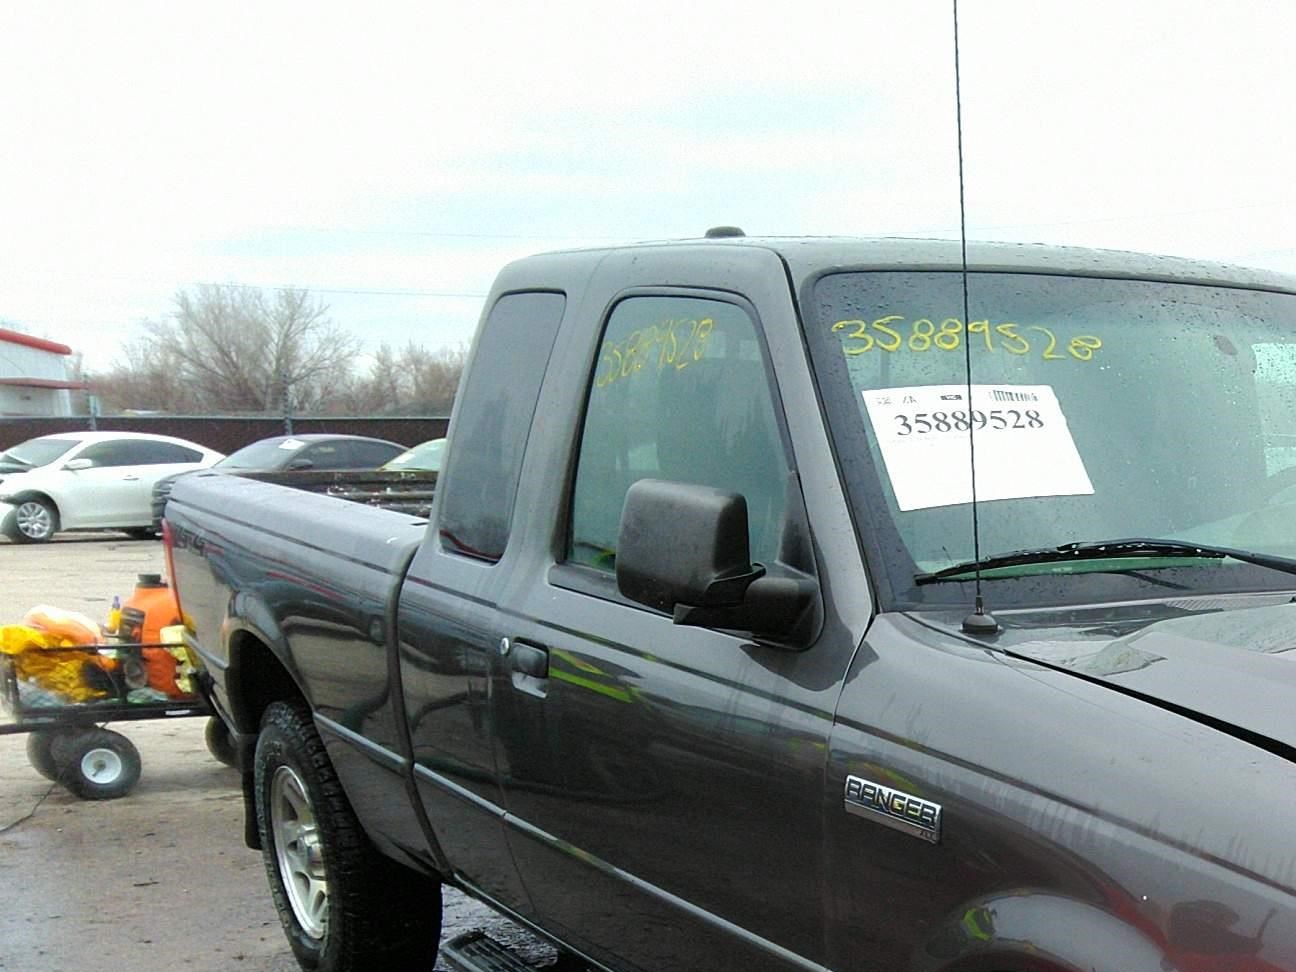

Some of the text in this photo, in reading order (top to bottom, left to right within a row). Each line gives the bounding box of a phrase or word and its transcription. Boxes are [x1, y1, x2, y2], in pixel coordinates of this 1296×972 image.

[832, 316, 1102, 360] 35889528
[893, 409, 1045, 436] 35889528
[846, 778, 937, 828] RANGER
